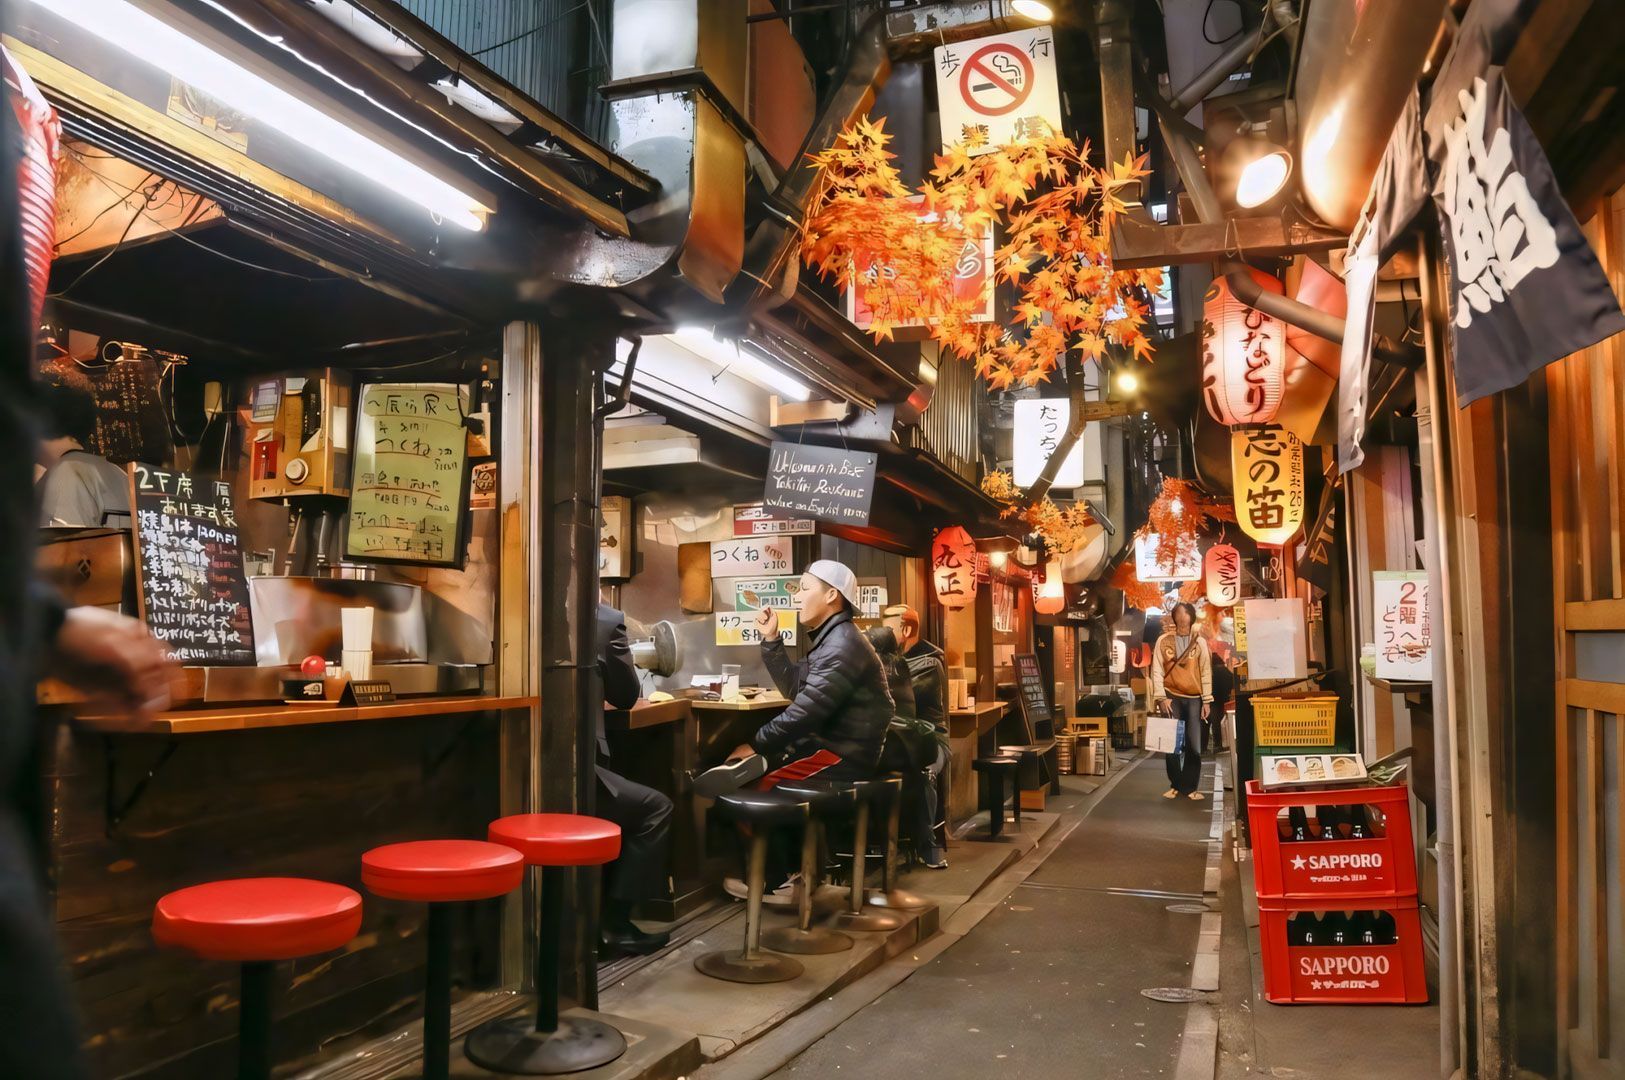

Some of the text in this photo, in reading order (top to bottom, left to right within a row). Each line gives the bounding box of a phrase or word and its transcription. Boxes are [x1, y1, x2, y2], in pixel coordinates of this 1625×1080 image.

[1244, 423, 1289, 529] 志の笛
[712, 546, 759, 562] つくね
[720, 615, 754, 627] サワー
[1309, 853, 1382, 869] SAPPORO
[1300, 955, 1390, 976] SAPPORO
